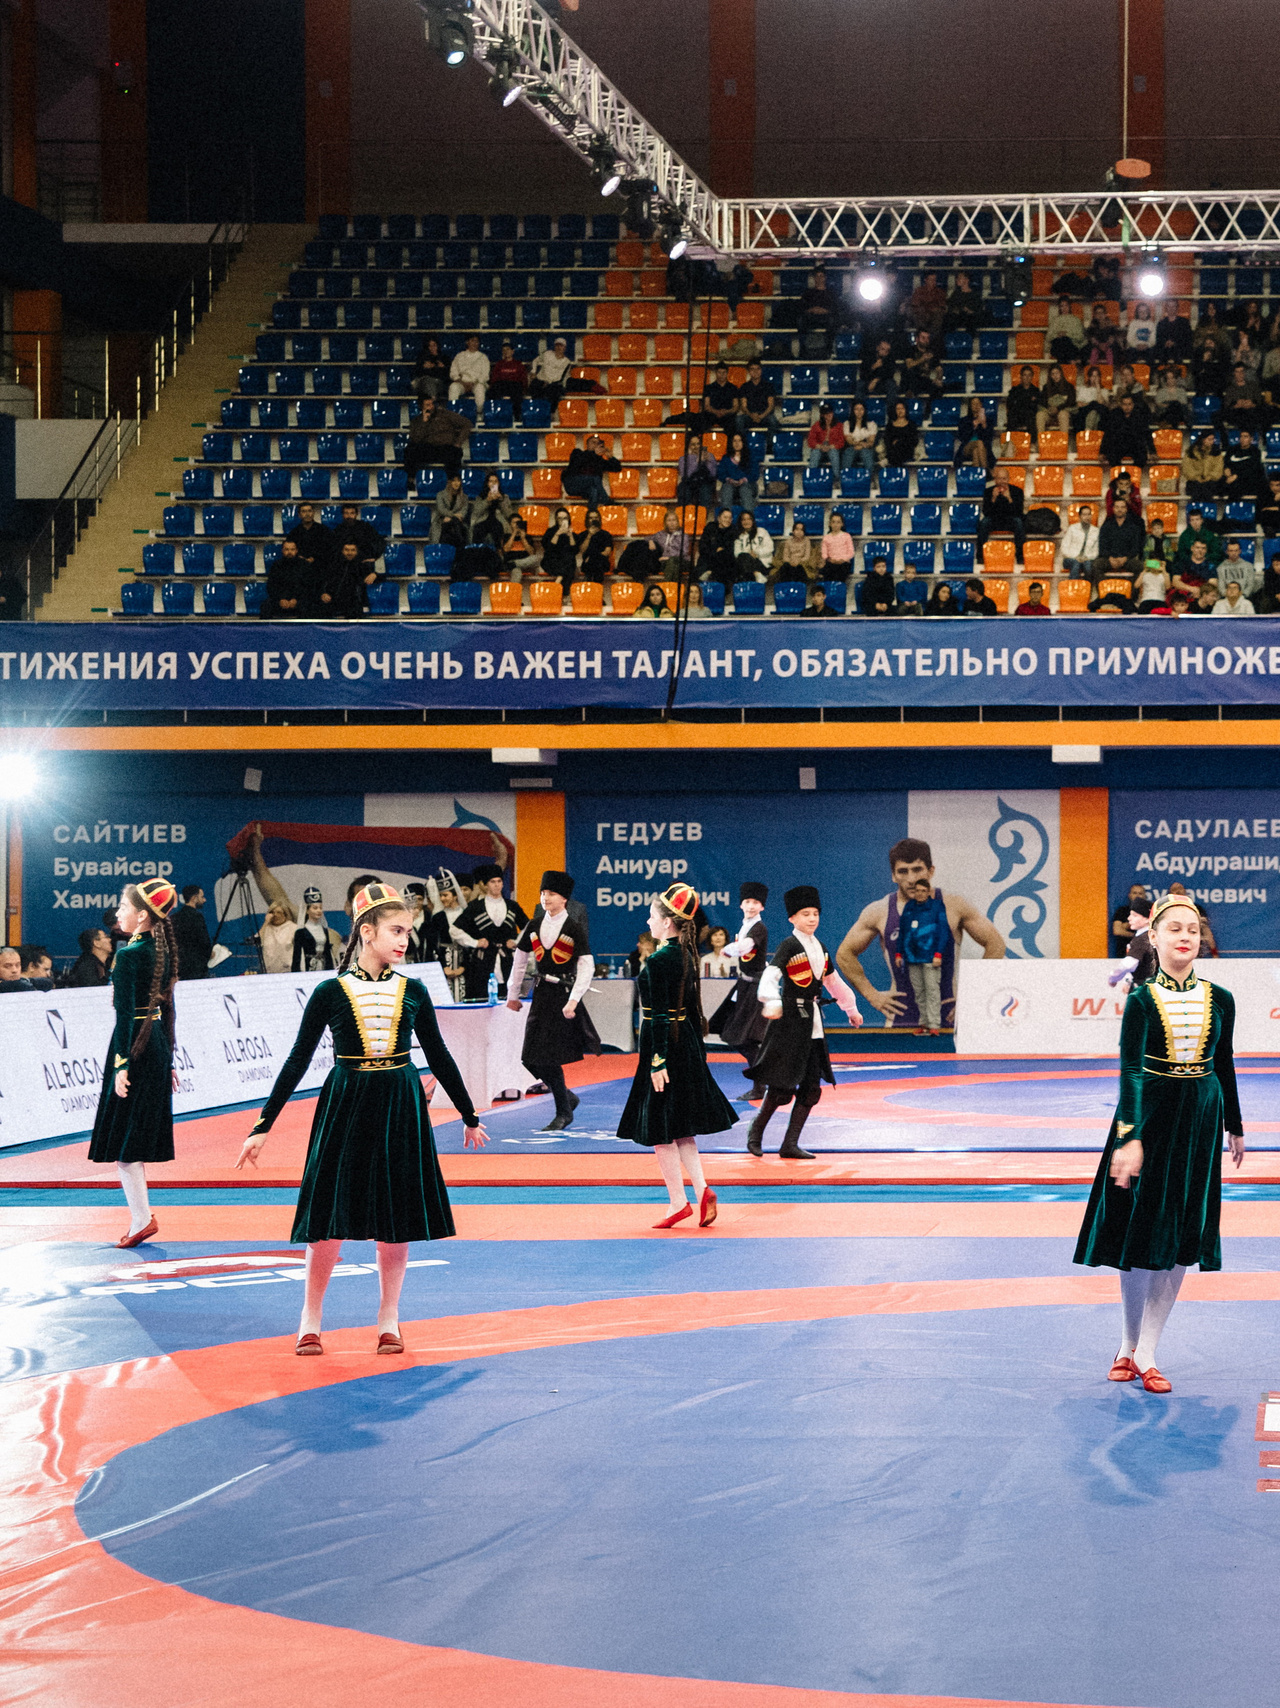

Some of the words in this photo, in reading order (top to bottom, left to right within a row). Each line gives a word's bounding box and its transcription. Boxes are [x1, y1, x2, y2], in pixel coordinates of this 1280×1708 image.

[190, 652, 330, 680] УСПЕХА
[340, 651, 463, 680] ОЧЕНЬ
[474, 651, 600, 679] ВАЖЕН
[612, 649, 763, 682] ТАЛАНТ,
[772, 648, 1038, 678] ОБЯЗАТЕЛЬНО
[53, 820, 187, 843] САЙТИЕВ
[597, 822, 703, 845] ГЕДУЕВ
[53, 857, 173, 882] Бувайсар
[596, 855, 688, 880] Аниуар
[597, 888, 730, 911] Бориич
[223, 1035, 273, 1063] ALROSA
[43, 1057, 104, 1091] ALROSA
